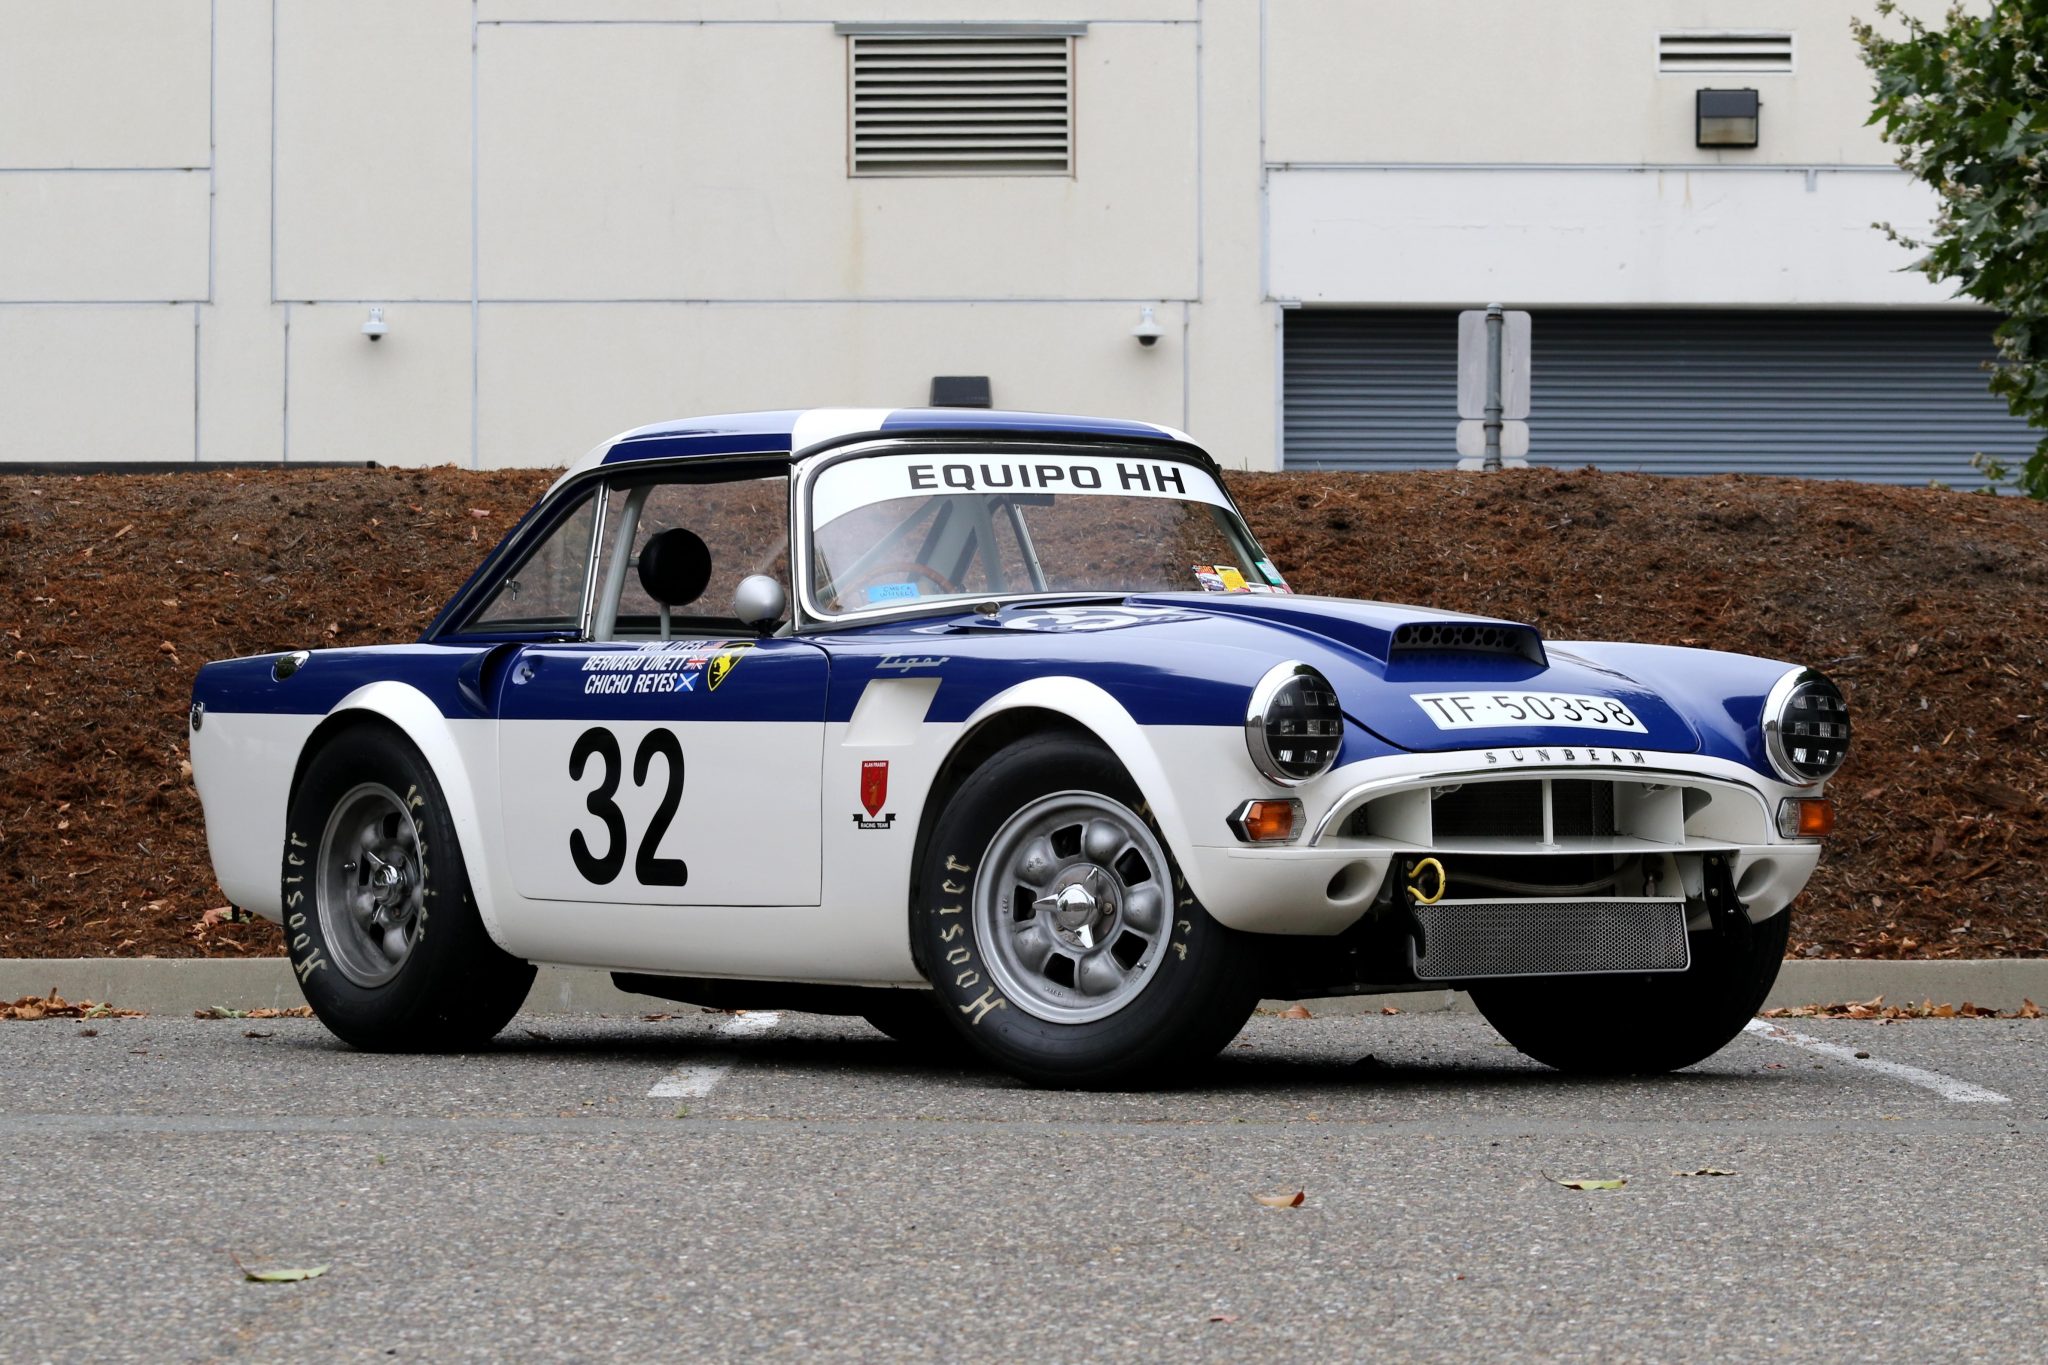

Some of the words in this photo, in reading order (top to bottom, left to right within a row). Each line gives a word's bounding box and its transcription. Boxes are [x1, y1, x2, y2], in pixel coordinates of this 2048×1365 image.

[907, 464, 1102, 491] EQUIPO
[1116, 462, 1186, 494] HH
[668, 640, 707, 651] DYER
[582, 655, 645, 671] BERNARD
[643, 655, 691, 671] UNETT
[875, 653, 950, 673] Tiger
[584, 673, 633, 694] CHICHO
[633, 672, 678, 693] REYES
[1484, 748, 1647, 765] SUNBEAM
[568, 726, 689, 887] 32
[285, 831, 328, 984] Hoosier
[937, 854, 1008, 1026] Hoosier
